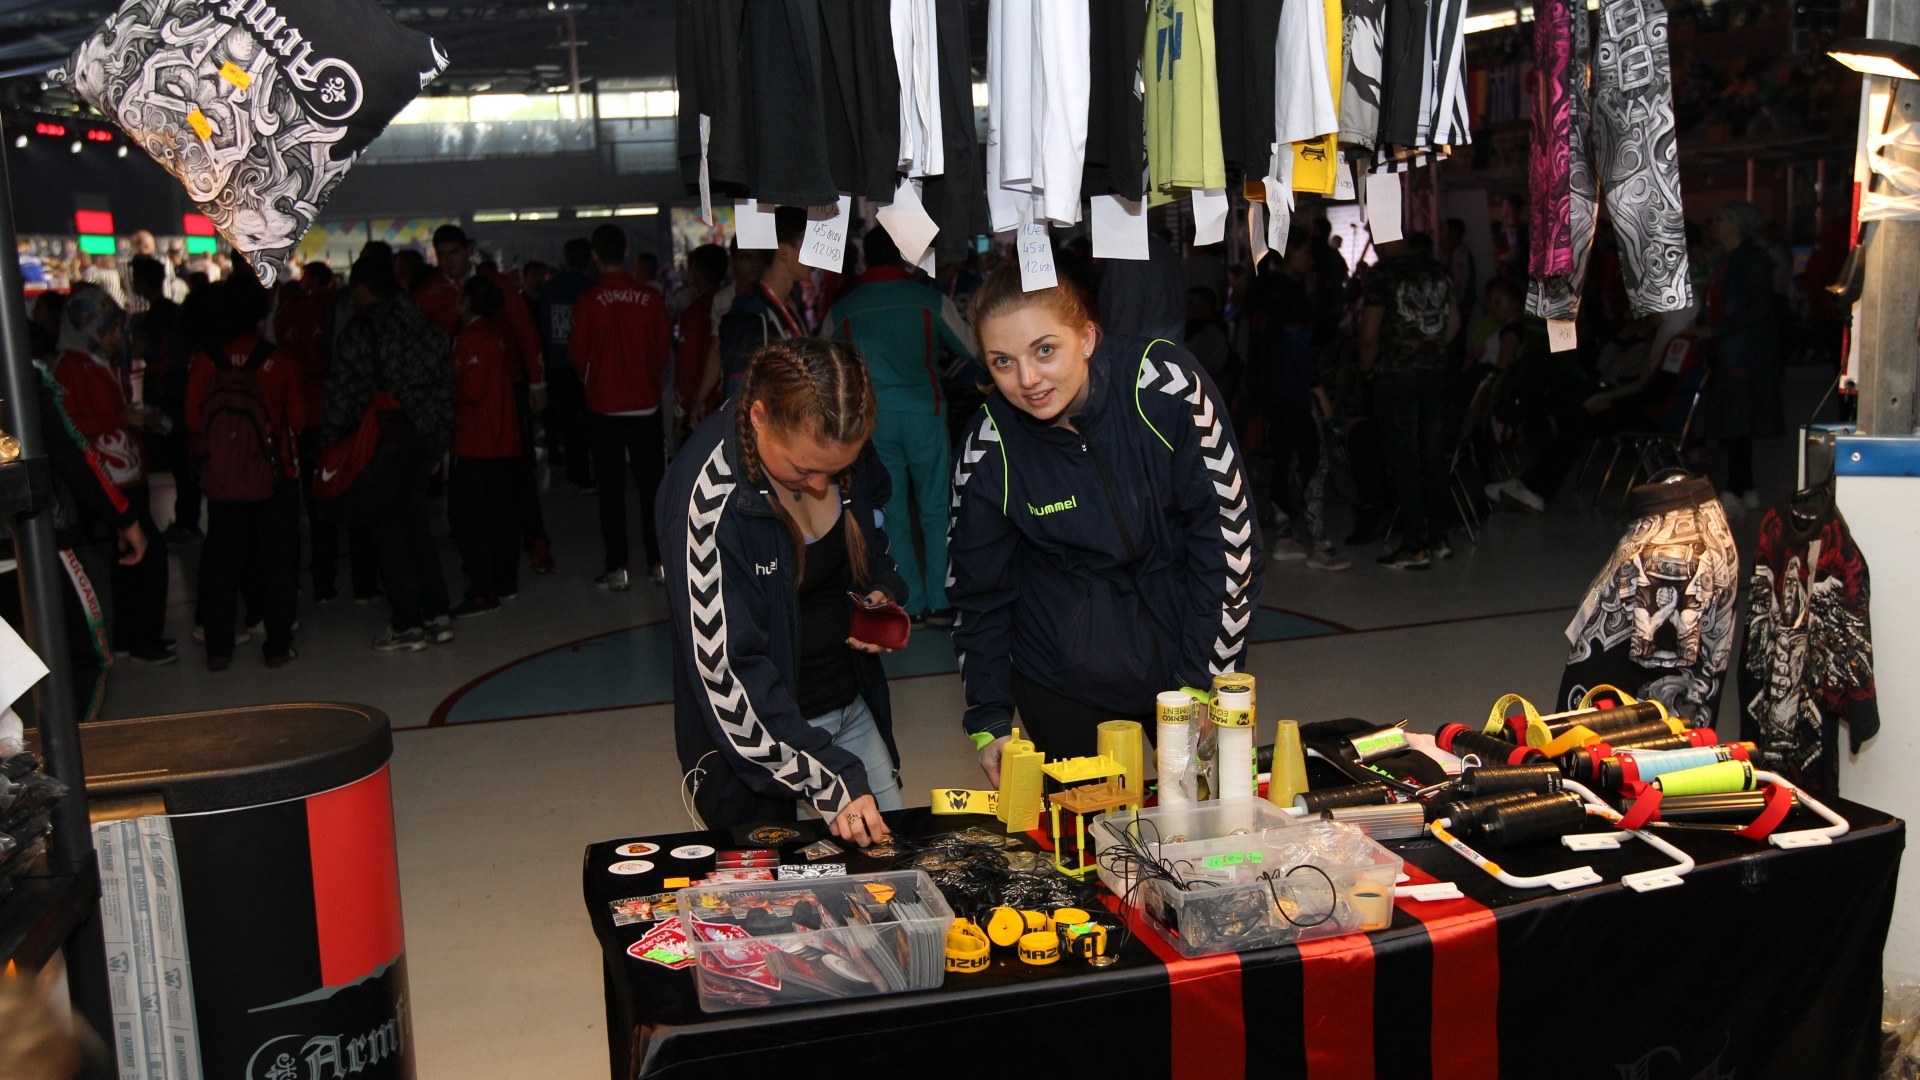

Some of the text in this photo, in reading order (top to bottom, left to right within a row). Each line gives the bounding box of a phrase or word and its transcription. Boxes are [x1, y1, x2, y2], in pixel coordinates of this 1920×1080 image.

[812, 241, 826, 255] 12
[1023, 242, 1037, 254] 45
[1024, 260, 1038, 273] 12
[596, 287, 651, 308] TÜRKİYE
[1026, 494, 1078, 516] hummel
